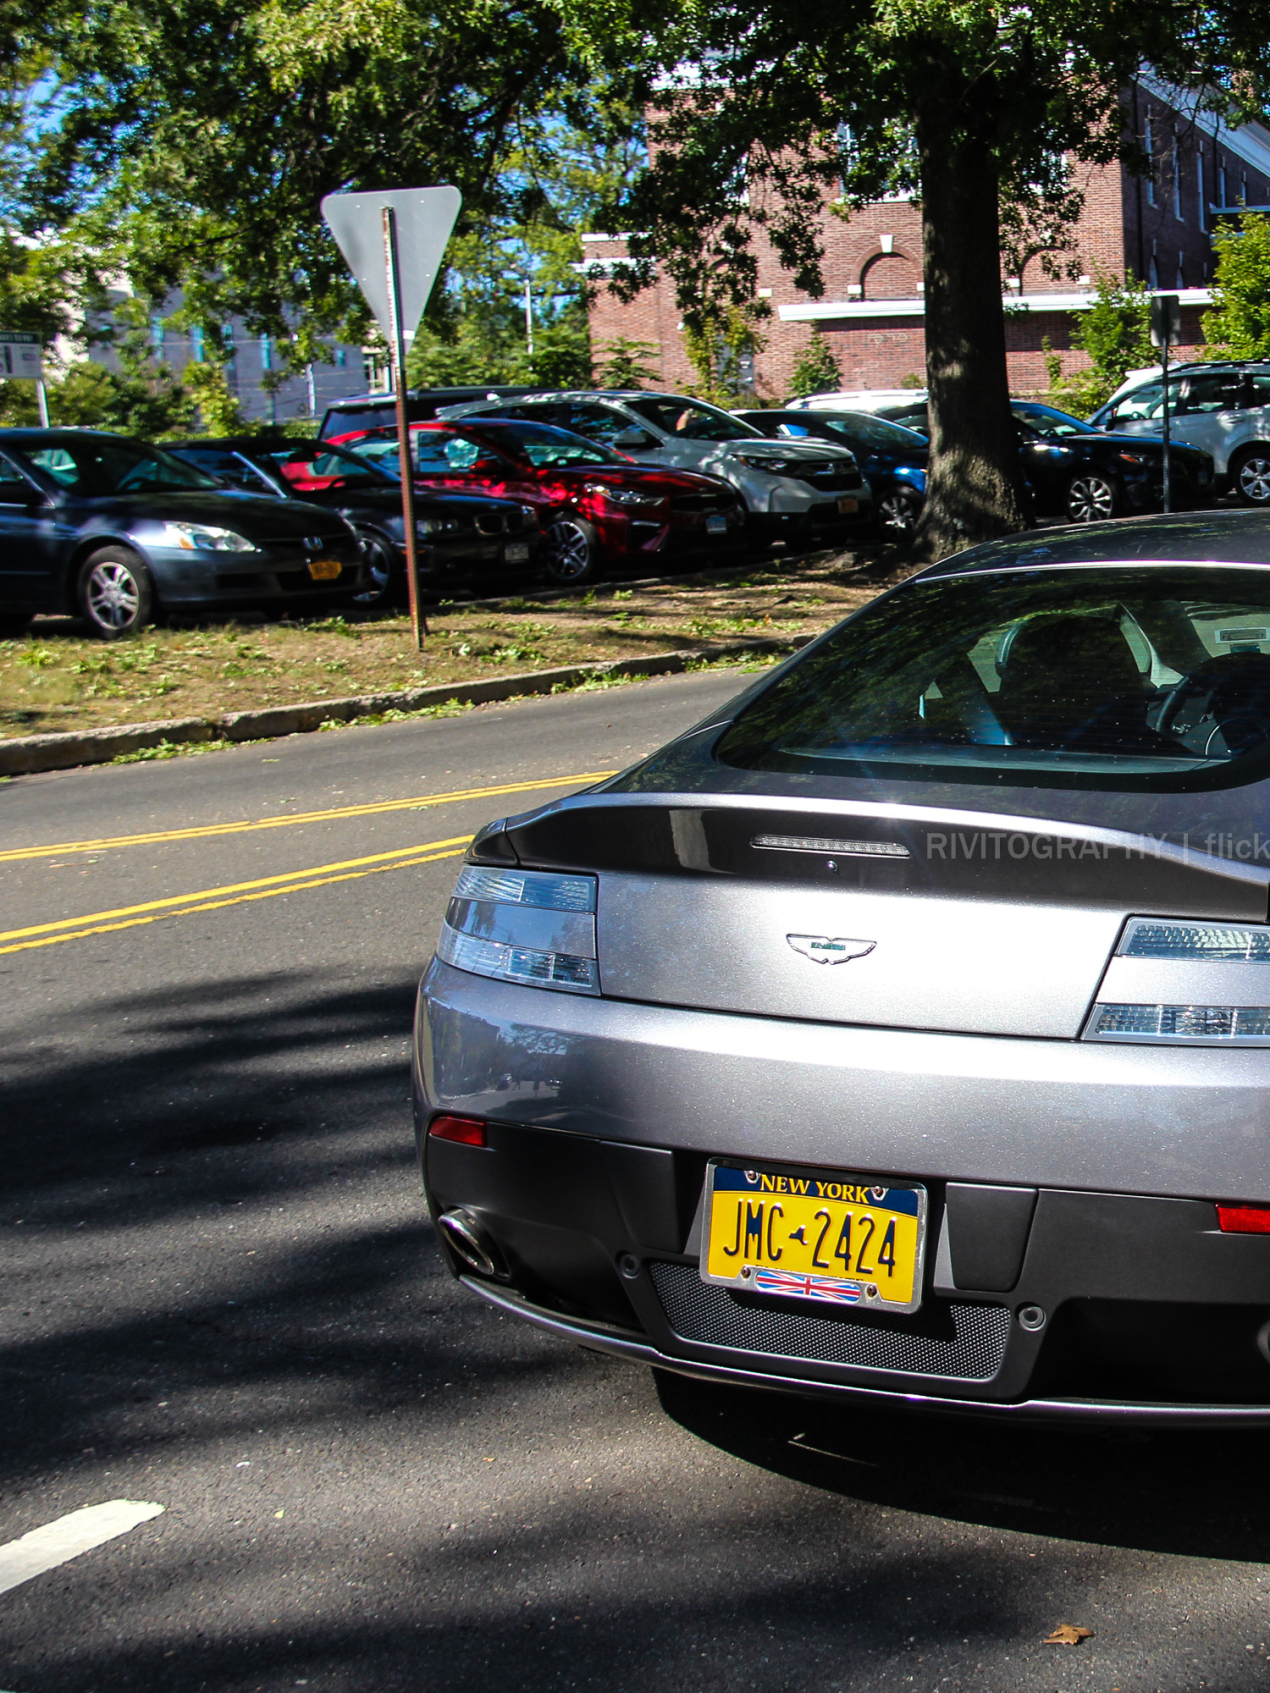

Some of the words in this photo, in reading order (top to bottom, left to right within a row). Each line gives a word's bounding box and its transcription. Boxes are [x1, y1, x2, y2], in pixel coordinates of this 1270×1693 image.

[760, 1174, 811, 1195] NEW
[816, 1180, 870, 1204] YORK
[723, 1198, 785, 1261] JMC
[812, 1207, 898, 1278] 2424
